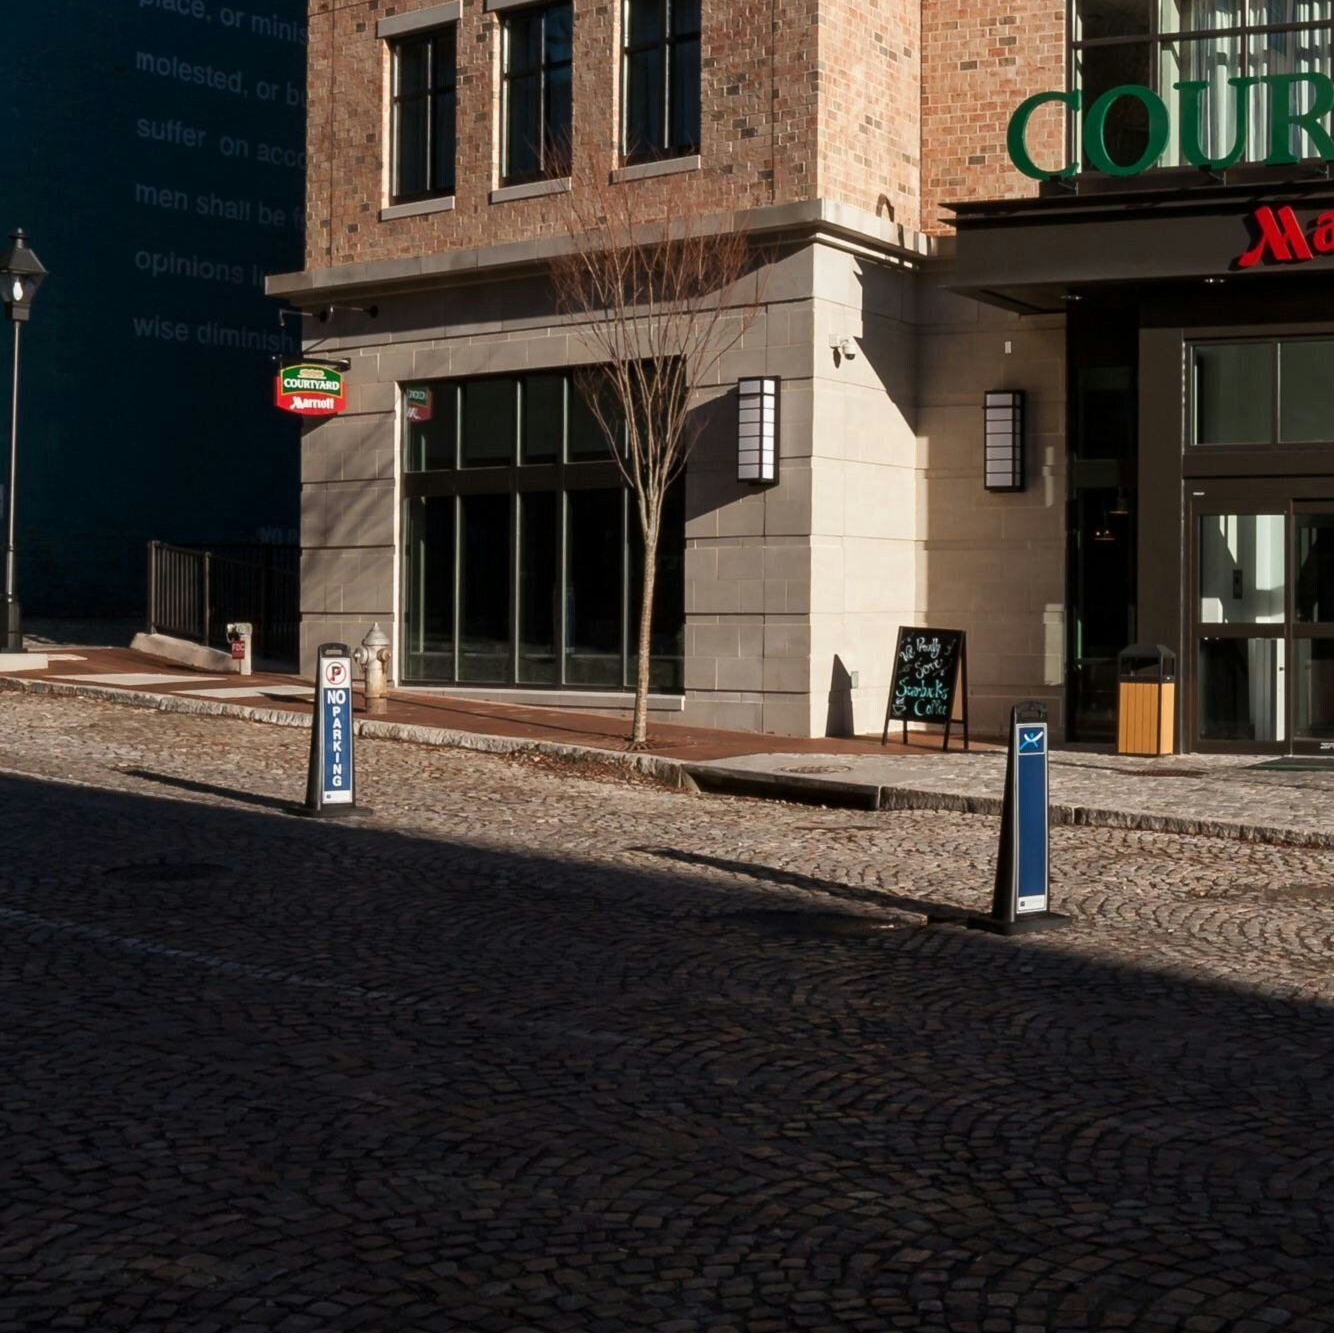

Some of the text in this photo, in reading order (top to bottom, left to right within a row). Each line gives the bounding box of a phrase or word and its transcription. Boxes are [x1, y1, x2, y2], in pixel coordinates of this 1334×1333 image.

[220, 7, 245, 28] or
[136, 50, 248, 99] molested,
[256, 80, 280, 101] or
[136, 117, 207, 148] suffer
[219, 135, 249, 158] on
[135, 182, 188, 212] men
[195, 192, 251, 221] shall
[258, 199, 286, 227] be
[135, 249, 245, 285] opinions
[132, 313, 295, 352] wise diminish
[284, 378, 340, 391] COURTYARD
[290, 396, 334, 410] Marriott
[327, 689, 346, 705] NO
[914, 698, 947, 716] Coffee
[332, 706, 342, 787] PARKING
